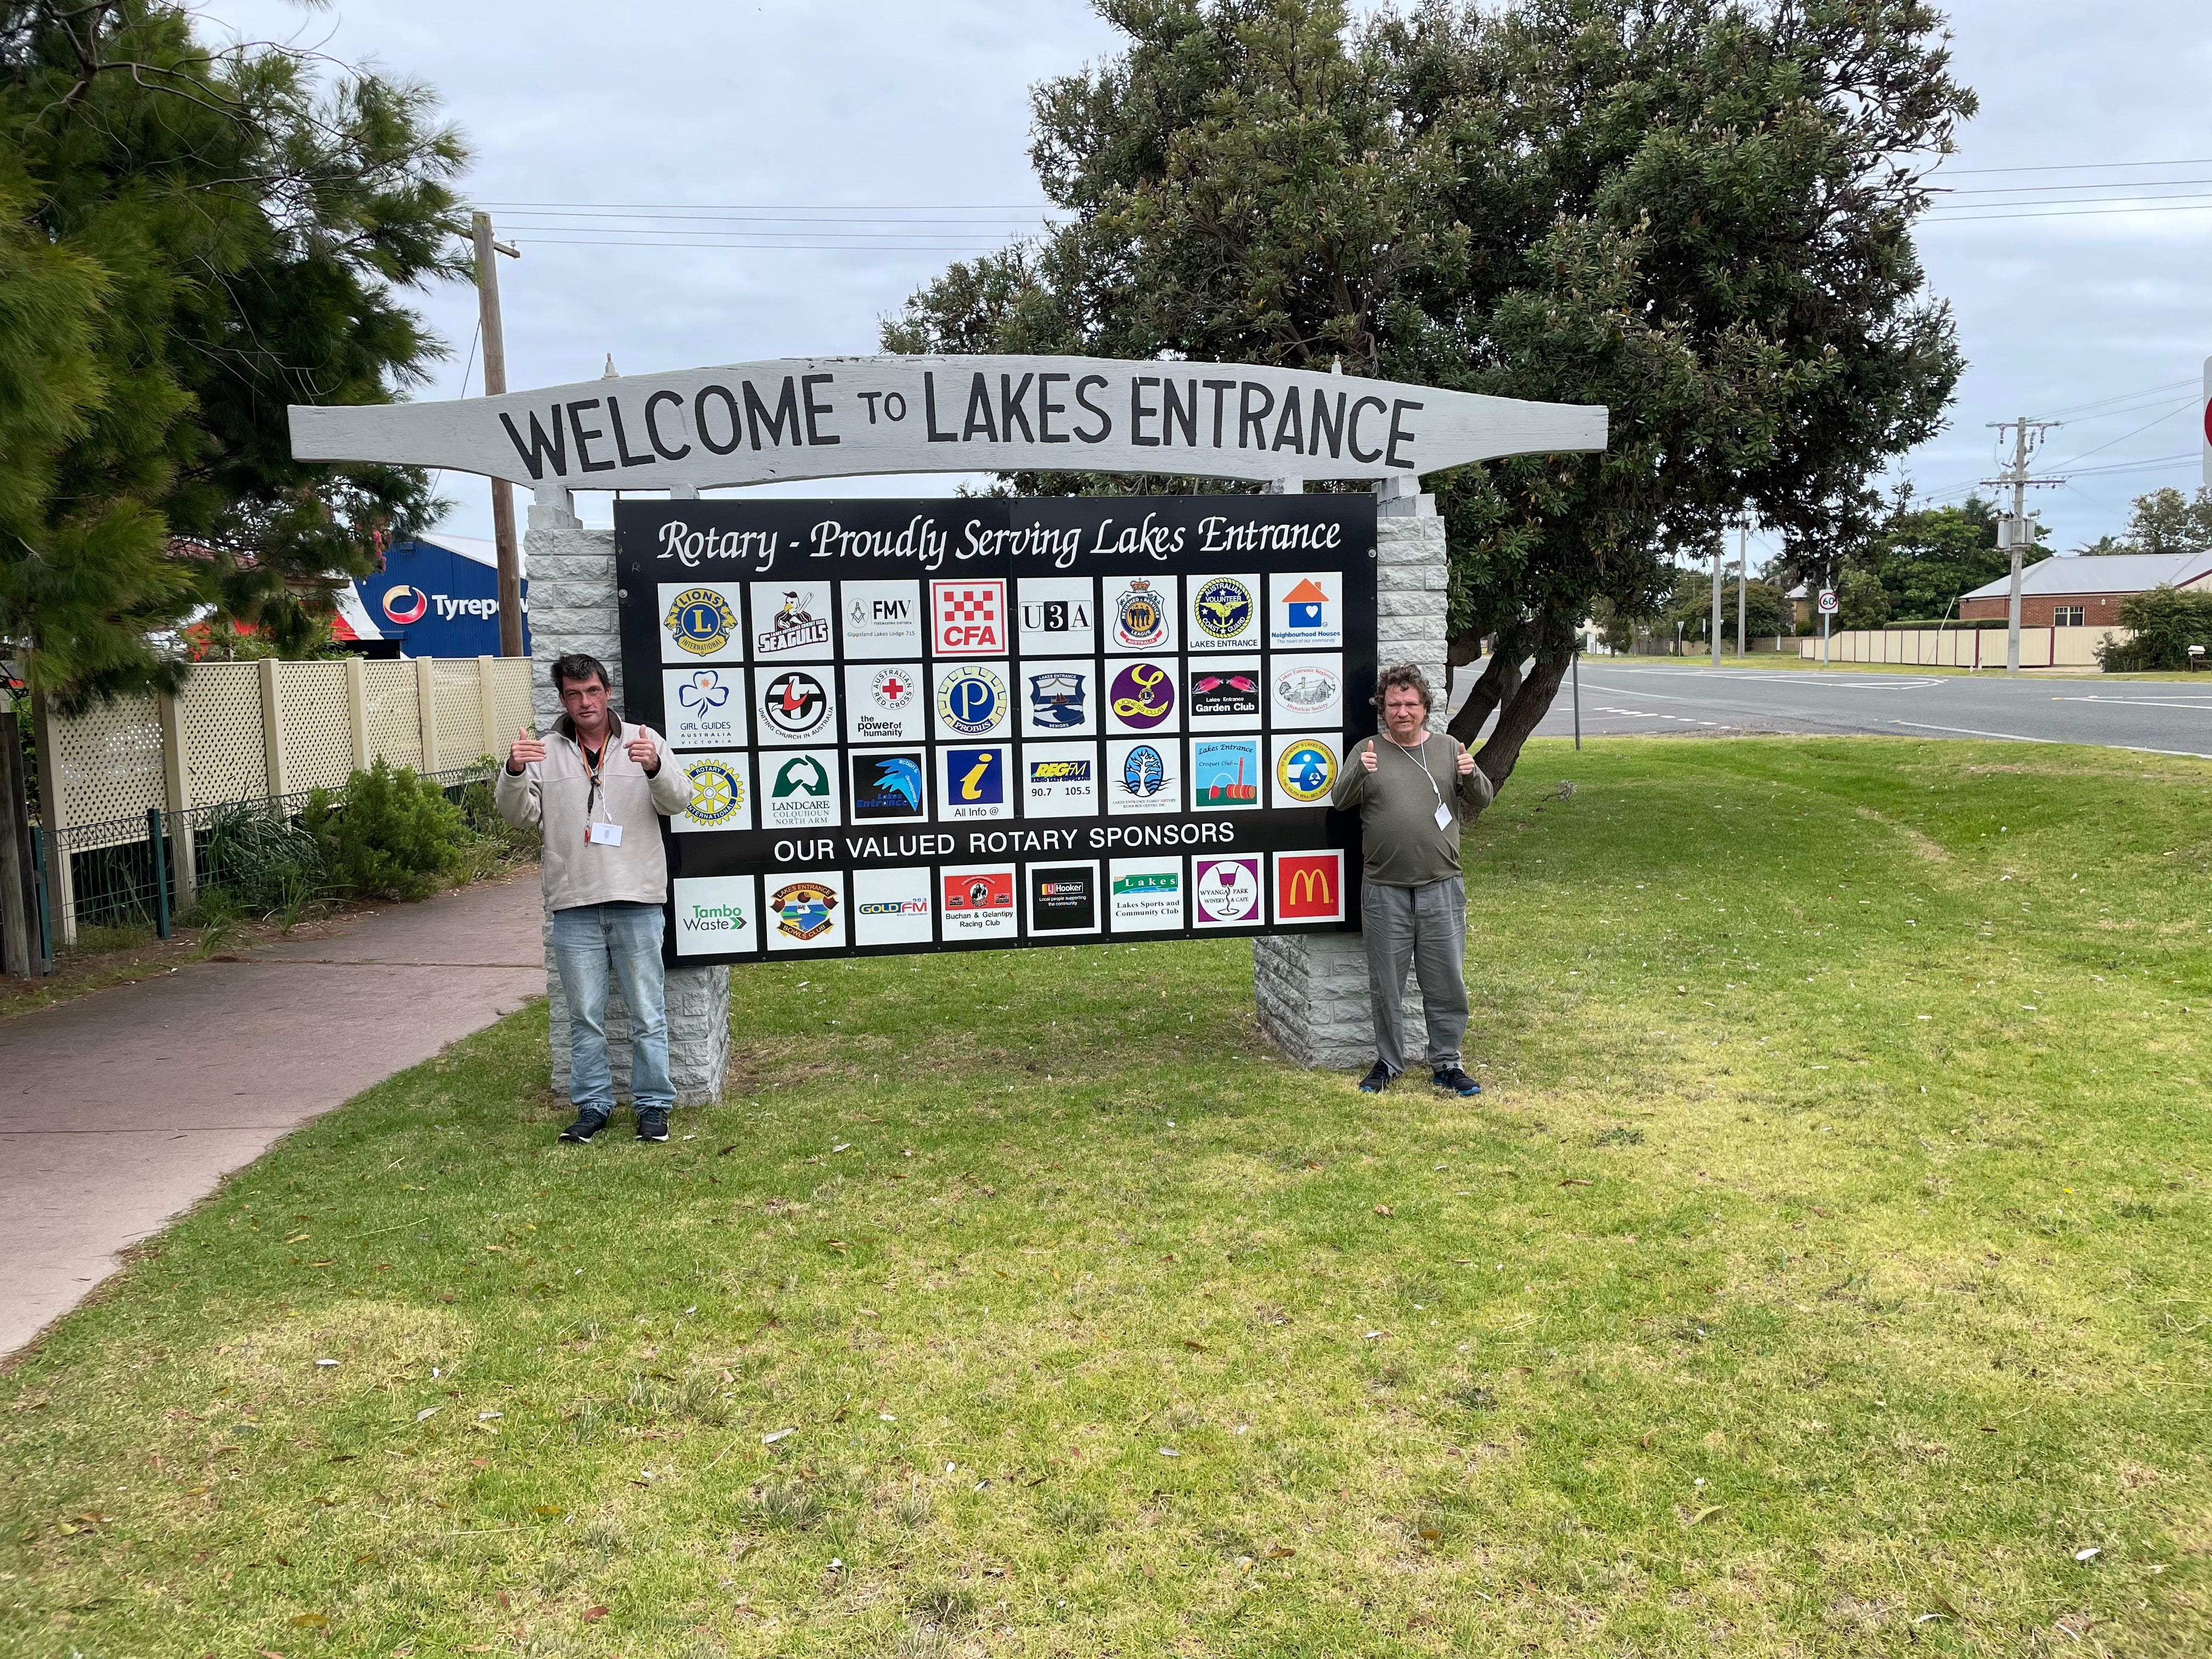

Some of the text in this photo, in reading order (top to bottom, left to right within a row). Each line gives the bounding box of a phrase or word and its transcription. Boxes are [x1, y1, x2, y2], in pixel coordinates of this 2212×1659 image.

[499, 371, 1424, 480] WELCOME TO LAKES ENTRANCE
[657, 520, 778, 572] Rotary
[810, 515, 949, 571] Proudly
[955, 518, 1082, 568] Serving
[1090, 512, 1186, 561] Lakes
[1198, 516, 1341, 552] Entrance
[1205, 583, 1243, 597] AUSTRALIAN
[679, 591, 721, 606] LIONS
[873, 600, 911, 619] FMV
[1121, 597, 1160, 619] RETURNED SERVICES
[692, 610, 712, 632] L
[1022, 604, 1091, 628] U3A
[1202, 616, 1245, 633] COAST GUARD
[759, 624, 828, 652] SEAGULLS
[944, 626, 996, 646] CFA
[1217, 639, 1258, 647] ENTRANCE
[681, 639, 723, 651] INTERNATIONAL
[873, 669, 912, 689] AUSTRALIAN
[1279, 672, 1293, 682] Lakes
[1316, 669, 1335, 681] Regional
[874, 691, 912, 709] RED CROSS
[960, 680, 988, 720] P
[1117, 699, 1164, 715] LIONESS CLUB
[1195, 702, 1255, 712] Garden Club
[1286, 703, 1328, 712] Historical Society
[701, 721, 731, 730] GUIDES
[758, 707, 775, 731] UNITING
[775, 729, 802, 740] CHURCH
[811, 706, 834, 736] AUSTRALIA
[954, 721, 991, 732] PROBUS
[864, 729, 902, 737] humanity
[1199, 744, 1254, 755] Lakes Entrance
[695, 766, 721, 774] ROTARY
[899, 759, 916, 770] action
[1031, 786, 1091, 797] 90.7 105.5
[771, 800, 830, 811] LANDCARE
[856, 799, 909, 808] Entrance
[687, 803, 734, 819] NTERNATIONAL
[773, 810, 829, 818] COLQUHOUN
[955, 806, 999, 817] All Info @
[774, 822, 1234, 862] OUR VALUED ROTARY SPONSORS
[1056, 884, 1081, 892] Hooker
[1125, 877, 1176, 887] Lakes
[777, 884, 831, 898] LAKES ENTRANCE
[692, 904, 742, 918] Tambo
[683, 918, 729, 932] Waste
[783, 924, 826, 939] BOWLS CLUB
